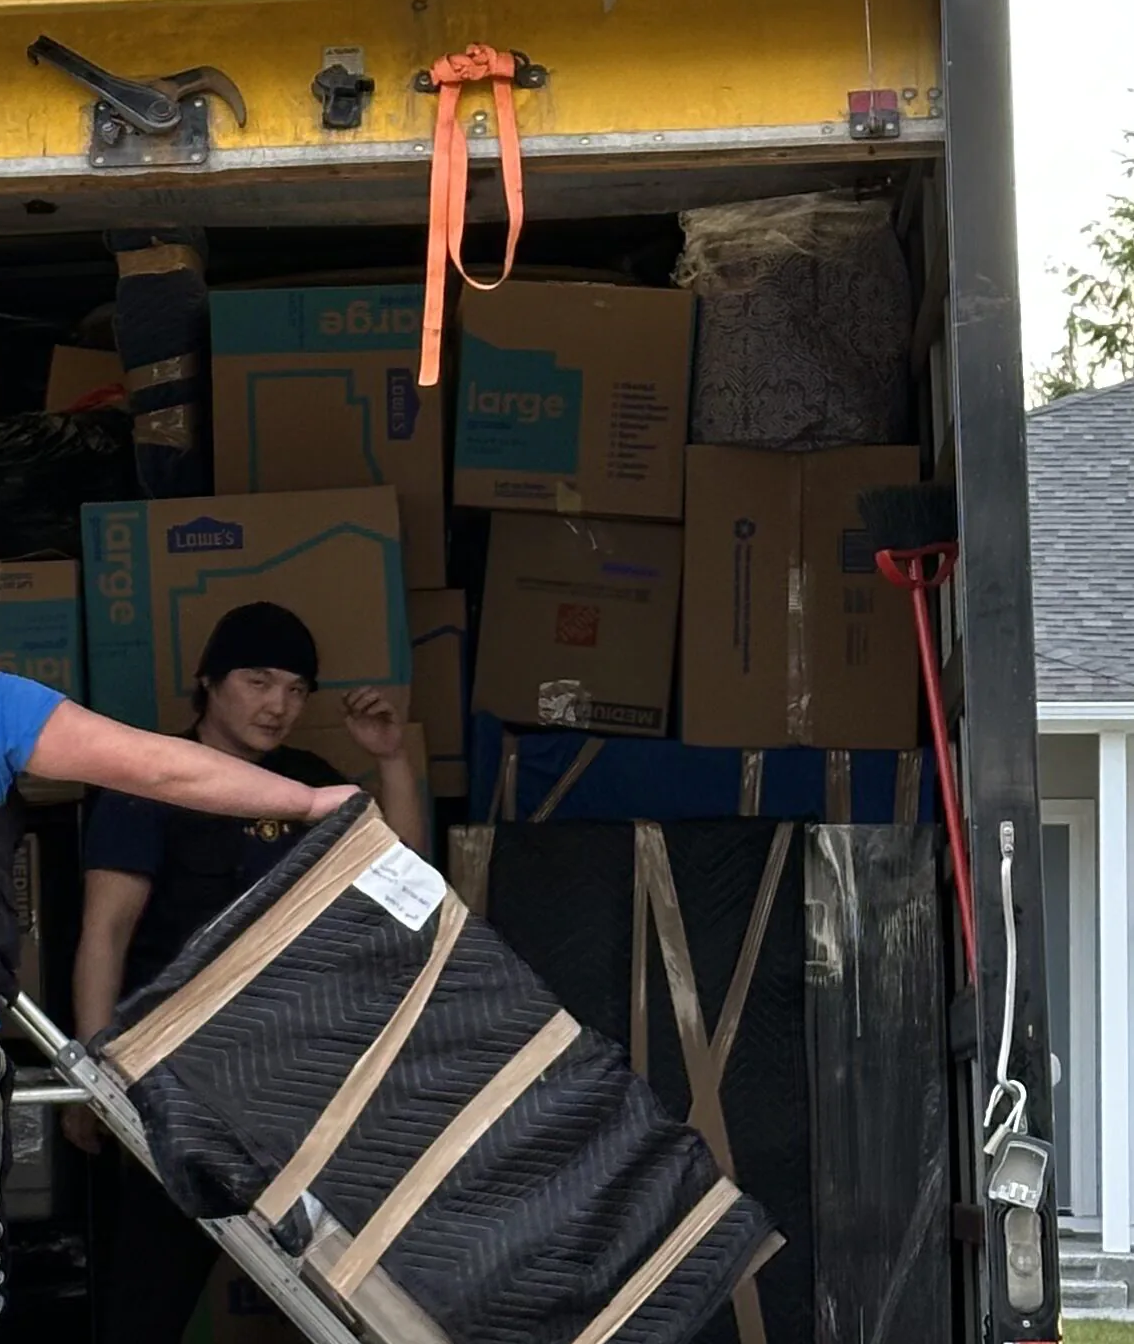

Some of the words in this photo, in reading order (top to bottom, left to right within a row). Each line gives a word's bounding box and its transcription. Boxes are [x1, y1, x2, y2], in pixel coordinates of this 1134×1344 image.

[319, 299, 422, 335] arge
[468, 379, 565, 423] large
[175, 528, 235, 548] LOWE'S
[98, 511, 140, 626] large
